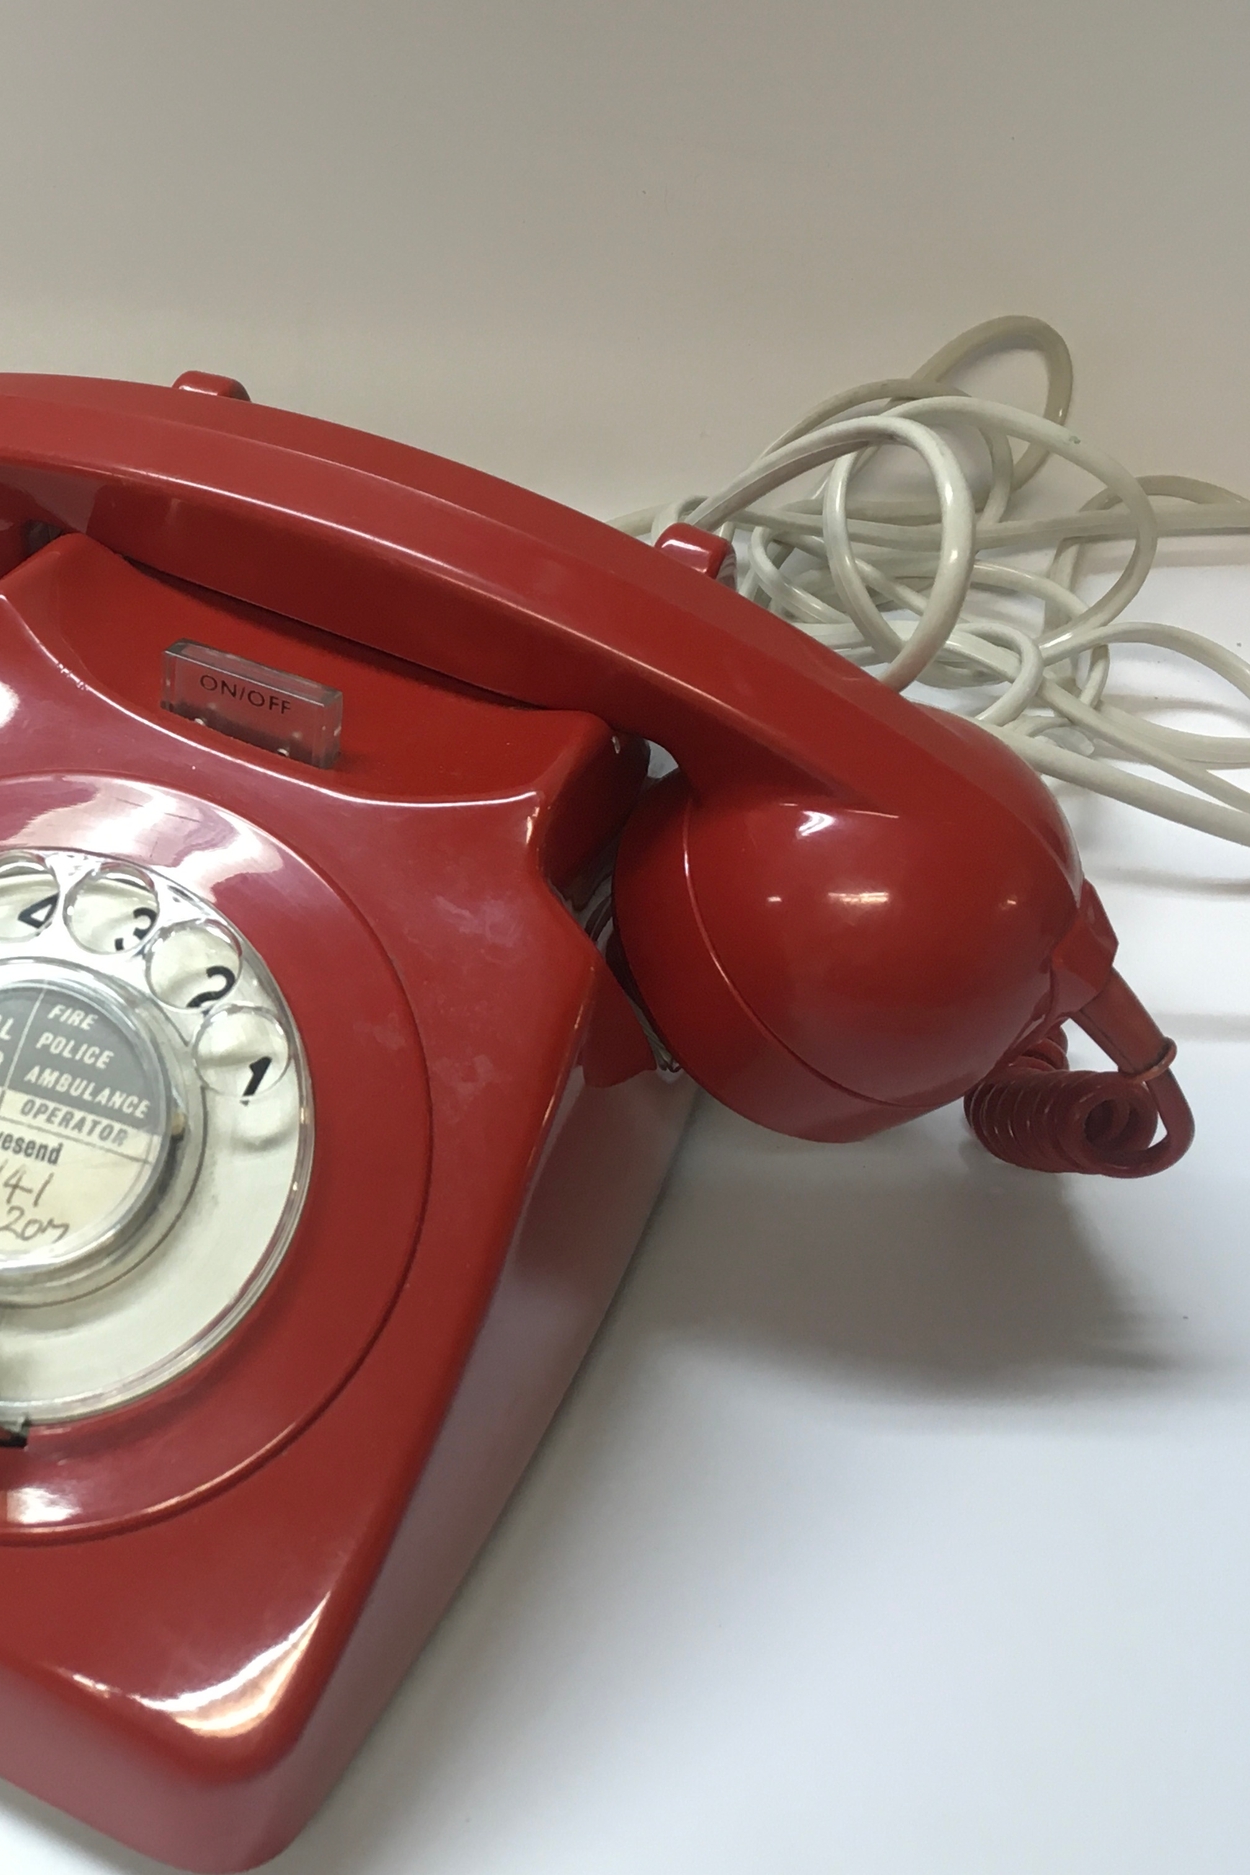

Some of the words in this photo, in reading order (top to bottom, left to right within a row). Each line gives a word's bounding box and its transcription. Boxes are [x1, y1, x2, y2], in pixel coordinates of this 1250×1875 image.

[200, 675, 291, 714] ON/OFF
[18, 894, 59, 937] 4
[115, 907, 156, 951] 3
[188, 966, 236, 1014] 2
[47, 1004, 98, 1031] FIRE
[36, 1032, 114, 1070] POLICE
[24, 1066, 151, 1119] AMBULANCE
[241, 1056, 272, 1106] 1
[21, 1099, 128, 1146] OPERATOR
